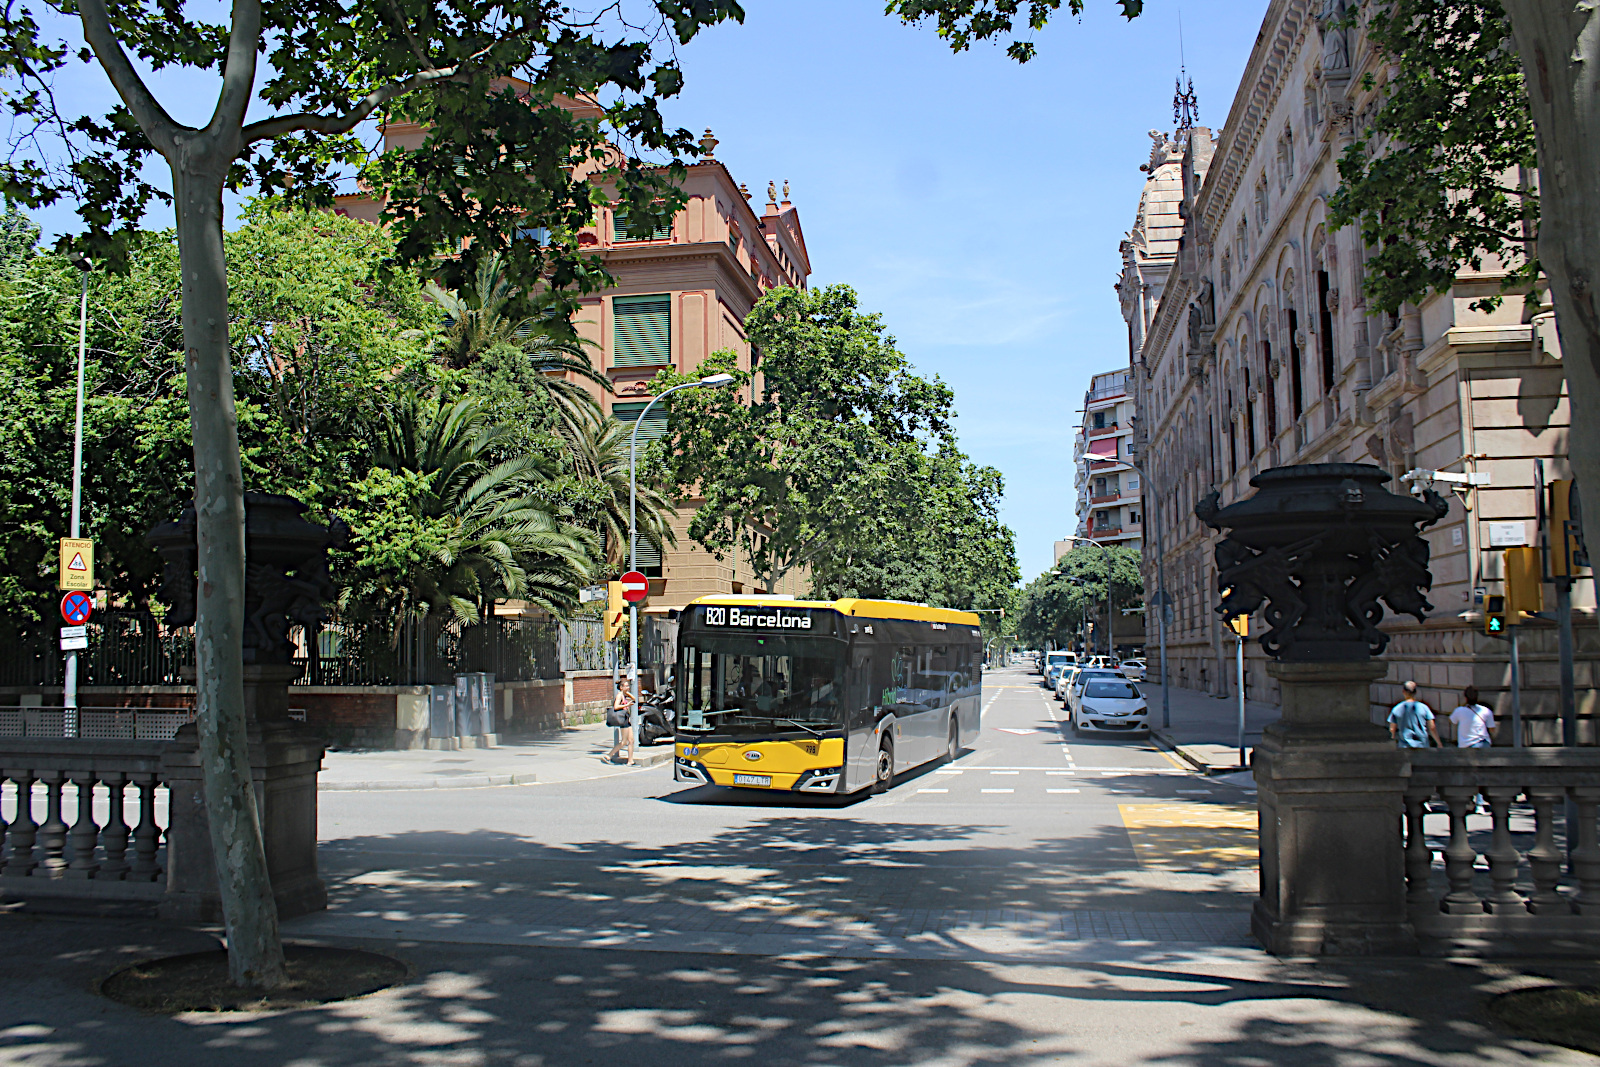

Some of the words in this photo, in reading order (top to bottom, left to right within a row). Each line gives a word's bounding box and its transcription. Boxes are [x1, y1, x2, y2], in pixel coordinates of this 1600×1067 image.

[64, 541, 92, 549] ATENCIÓ
[706, 607, 726, 625] B20
[729, 608, 811, 629] Barcelona
